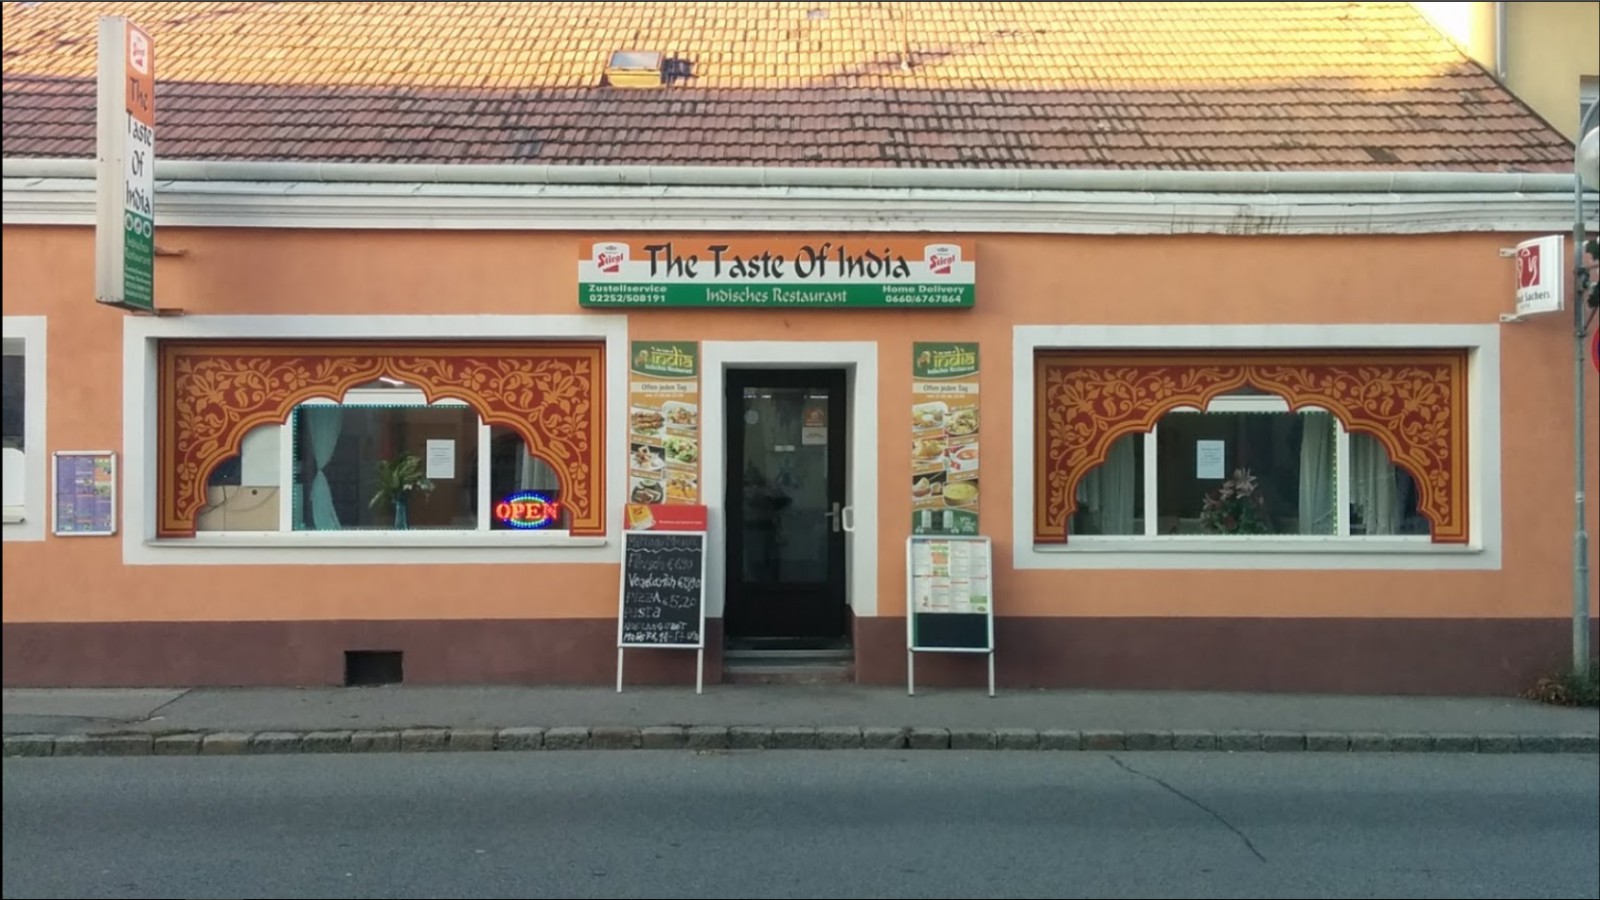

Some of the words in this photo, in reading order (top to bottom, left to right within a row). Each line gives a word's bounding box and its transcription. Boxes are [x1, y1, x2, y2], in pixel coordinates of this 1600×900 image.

[130, 77, 148, 111] The
[126, 108, 152, 147] Taste
[132, 150, 145, 177] Of
[126, 180, 151, 214] India
[643, 242, 698, 279] The
[707, 244, 784, 279] Taste
[794, 242, 832, 279] Of
[838, 244, 911, 279] India
[588, 284, 667, 293] Zustellservice
[706, 286, 768, 303] Indisches
[772, 287, 848, 303] Restaurant
[882, 285, 916, 294] Home
[918, 285, 965, 295] Delivery
[589, 294, 666, 303] 02252/508191
[885, 295, 962, 303] 0660/6767864
[495, 502, 559, 520] OPEN
